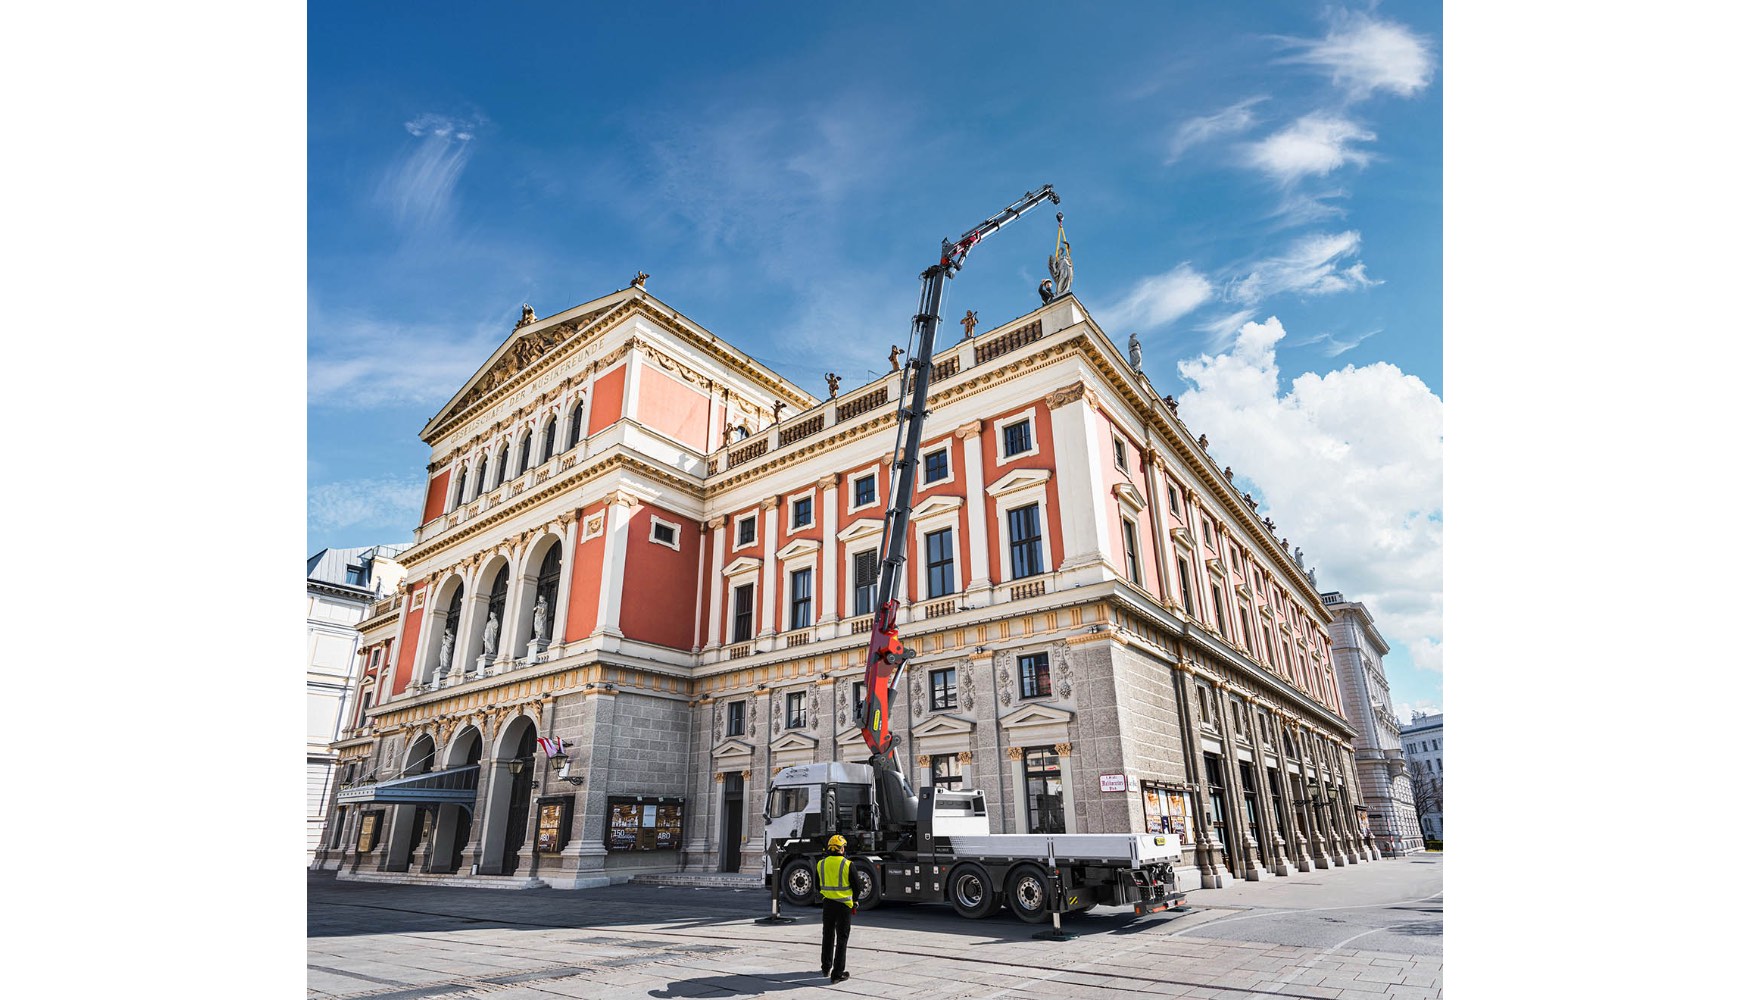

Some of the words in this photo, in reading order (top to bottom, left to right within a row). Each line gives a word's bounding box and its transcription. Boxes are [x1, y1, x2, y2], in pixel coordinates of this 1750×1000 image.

[450, 403, 504, 443] GESELLSCHAFT
[509, 391, 526, 406] DER
[530, 337, 605, 393] MUSIKFREUNDE
